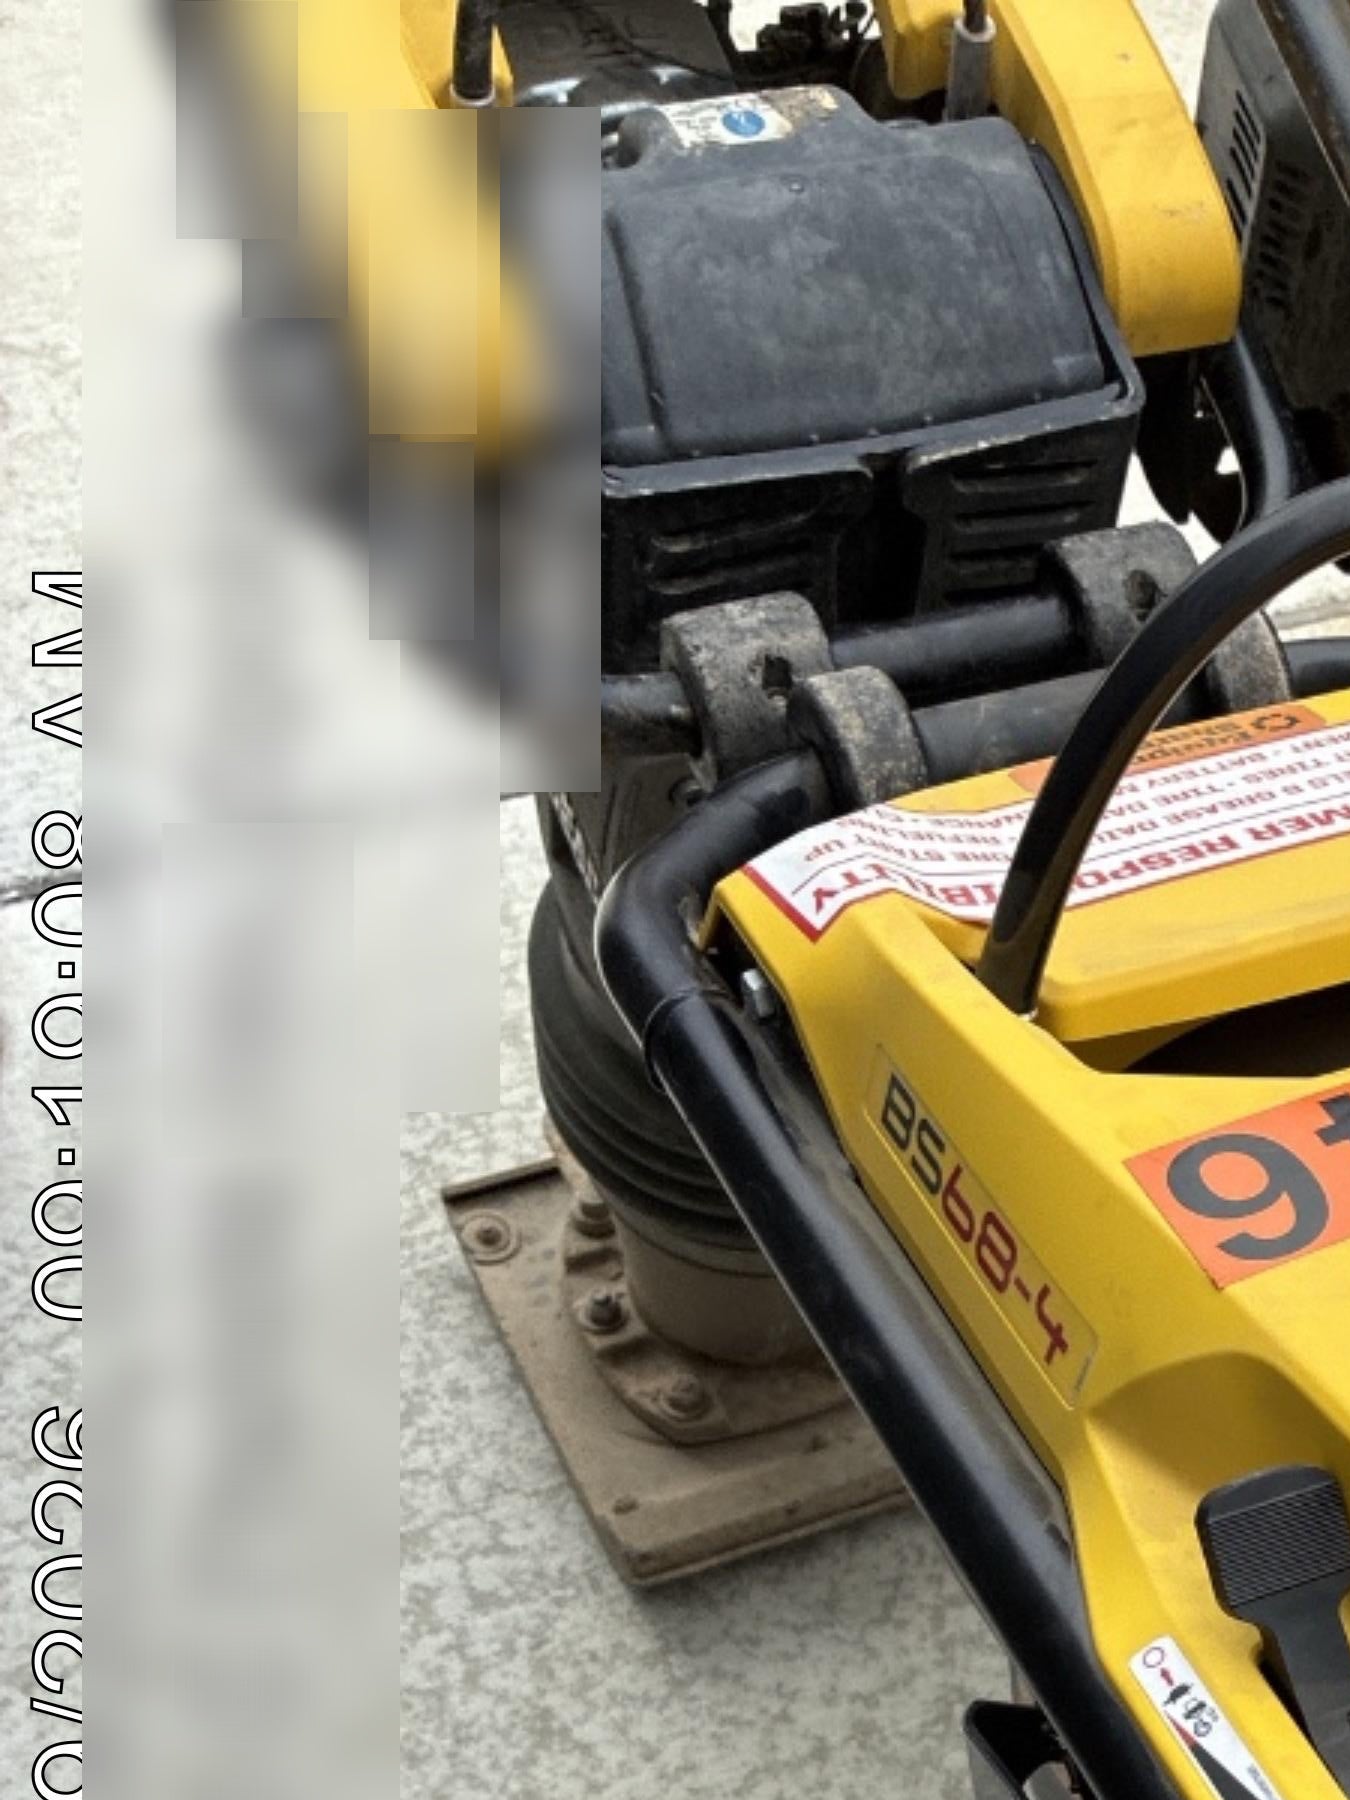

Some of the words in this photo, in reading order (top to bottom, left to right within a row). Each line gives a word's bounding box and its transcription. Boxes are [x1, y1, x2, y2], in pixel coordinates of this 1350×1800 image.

[1147, 749, 1270, 789] BATTERY
[1235, 759, 1330, 790] TIRES
[1151, 778, 1226, 805] TIRE
[1165, 785, 1277, 825] GREASE
[880, 1072, 1070, 1367] BS68-4
